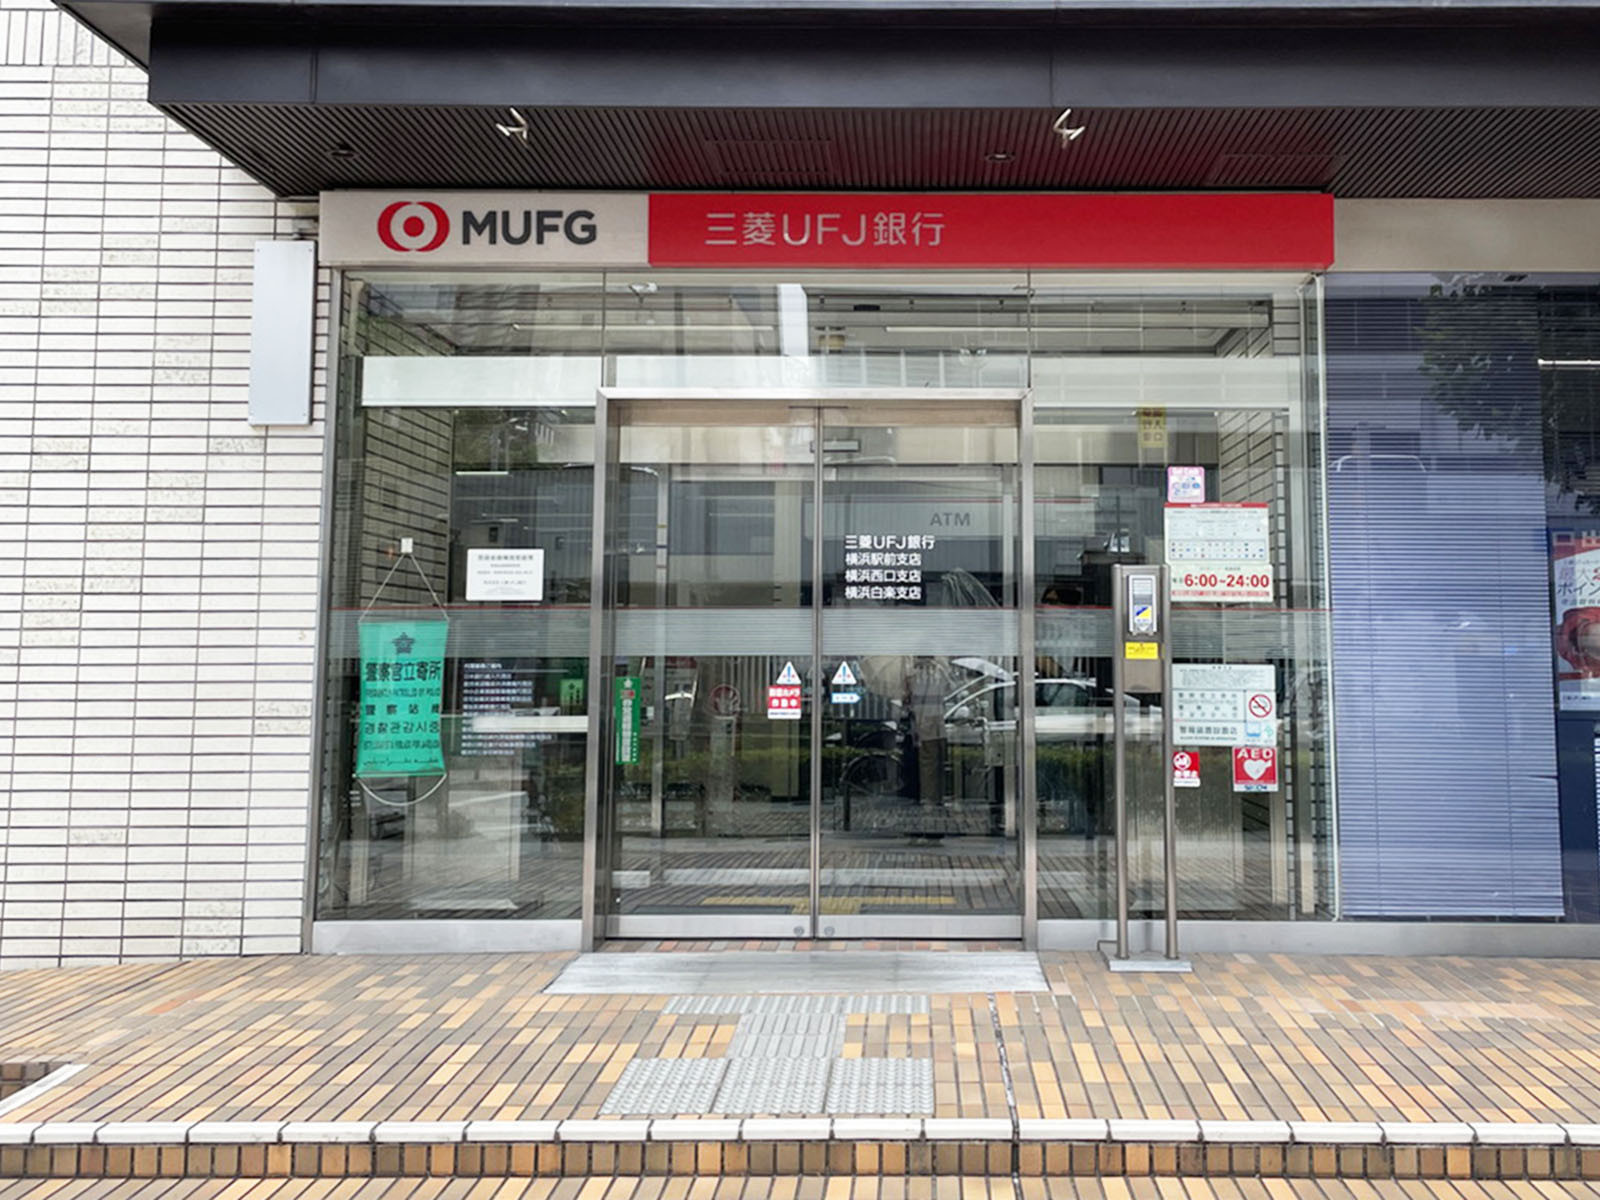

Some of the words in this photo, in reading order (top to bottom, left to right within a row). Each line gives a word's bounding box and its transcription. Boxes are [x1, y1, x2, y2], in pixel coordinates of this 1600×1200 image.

[463, 210, 596, 246] MUFG
[706, 211, 945, 248] 三菱UFJ銀行
[930, 512, 971, 526] ATM
[844, 535, 935, 549] 三菱UFJ銀行
[844, 553, 922, 567] 横浜駅前支店
[844, 569, 922, 583] 横浜西口支店
[1236, 748, 1274, 760] AED
